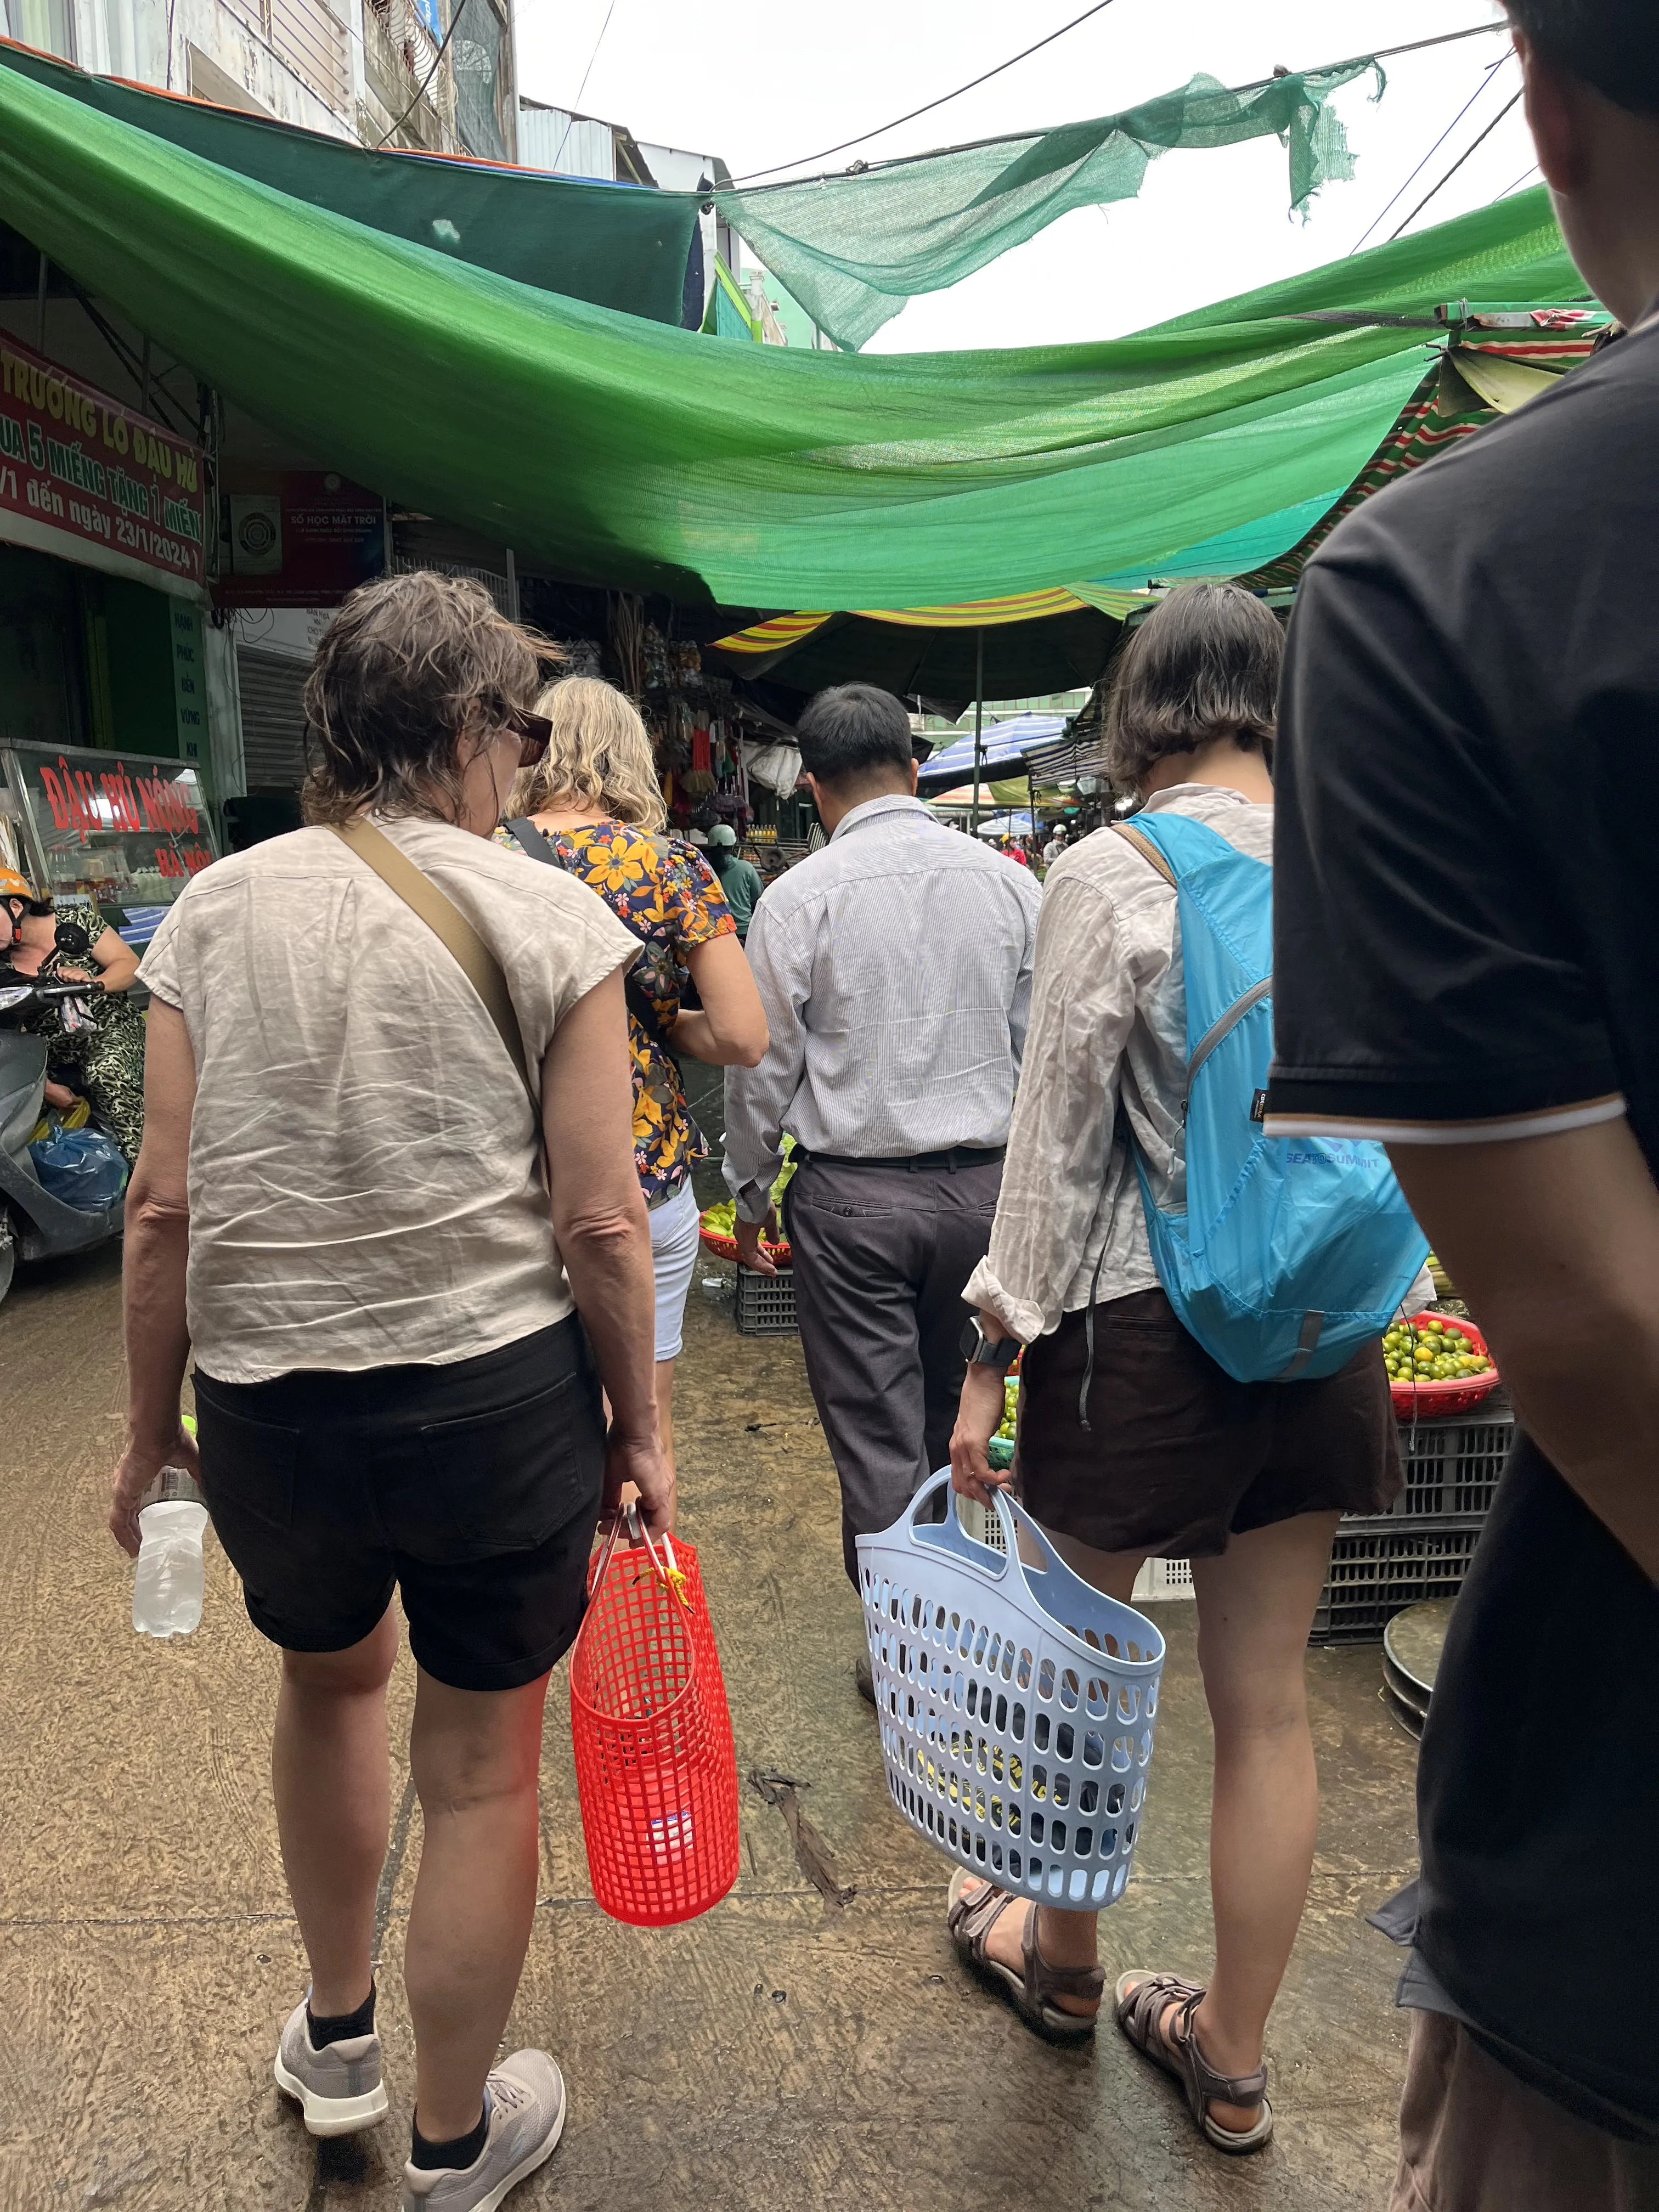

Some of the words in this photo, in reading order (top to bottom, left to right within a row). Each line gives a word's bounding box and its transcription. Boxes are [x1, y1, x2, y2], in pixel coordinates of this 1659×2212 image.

[0, 413, 27, 464] UA
[27, 418, 46, 471] 5
[164, 495, 204, 546] MIẾN
[0, 465, 18, 500] /1
[26, 477, 64, 517] đến
[69, 494, 110, 540] ngày
[40, 755, 102, 843] ĐẬU
[155, 842, 184, 877] HÀ
